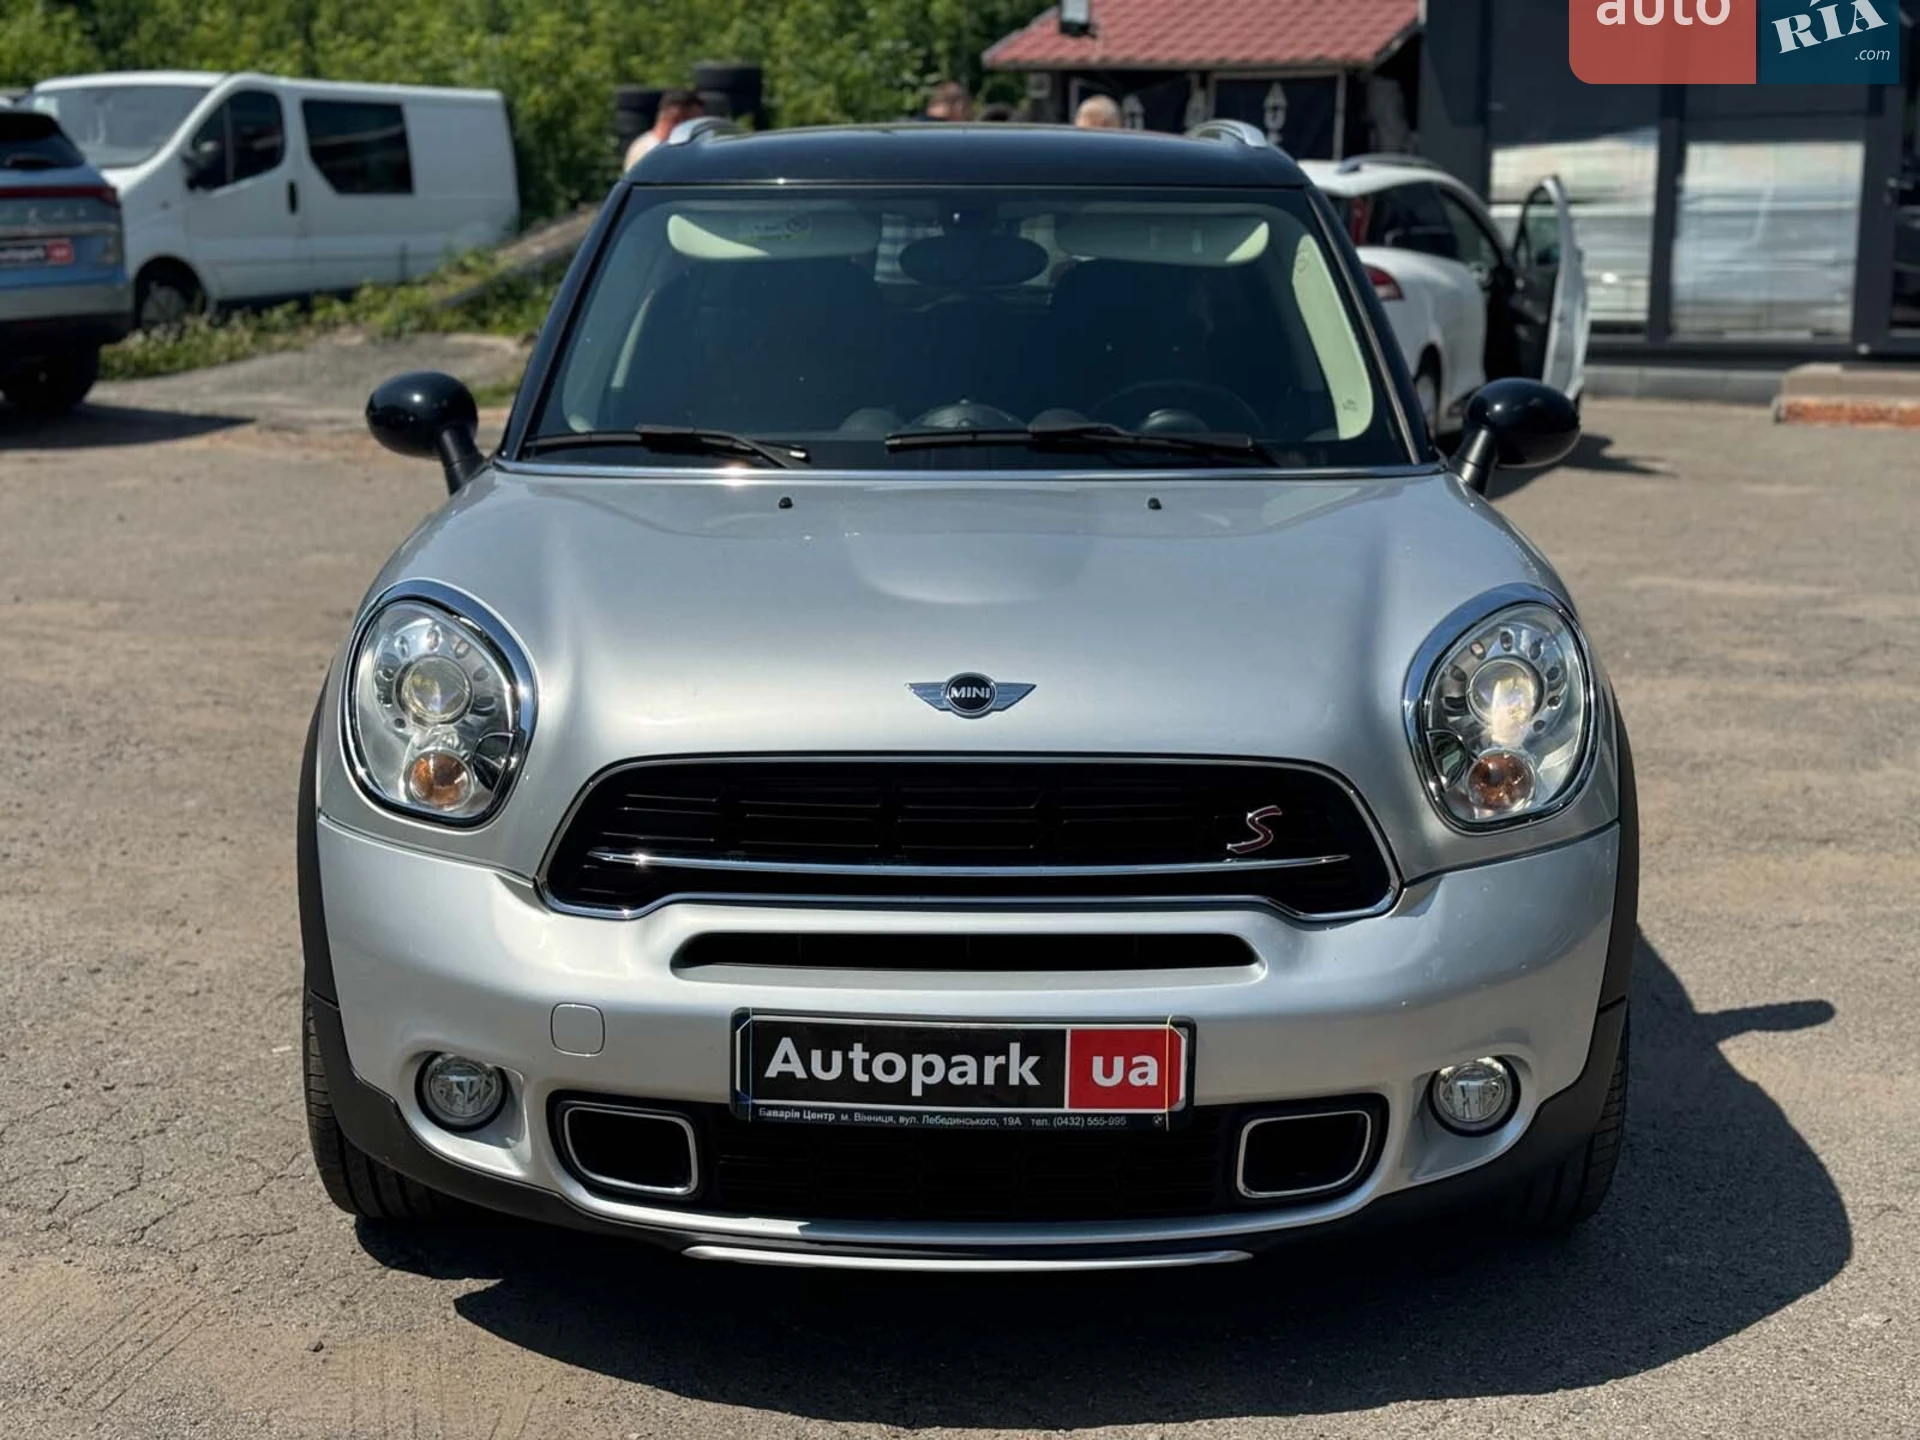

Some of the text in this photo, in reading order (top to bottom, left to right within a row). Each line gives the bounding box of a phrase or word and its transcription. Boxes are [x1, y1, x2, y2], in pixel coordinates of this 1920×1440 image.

[950, 686, 991, 698] MINI
[1226, 804, 1283, 854] S
[764, 1036, 1159, 1097] Autopark ua
[803, 1109, 836, 1122] Центр
[853, 1111, 897, 1124] Вінниця,
[899, 1115, 919, 1126] вул.
[1031, 1117, 1049, 1127] тел.
[1053, 1116, 1085, 1129] (0432)
